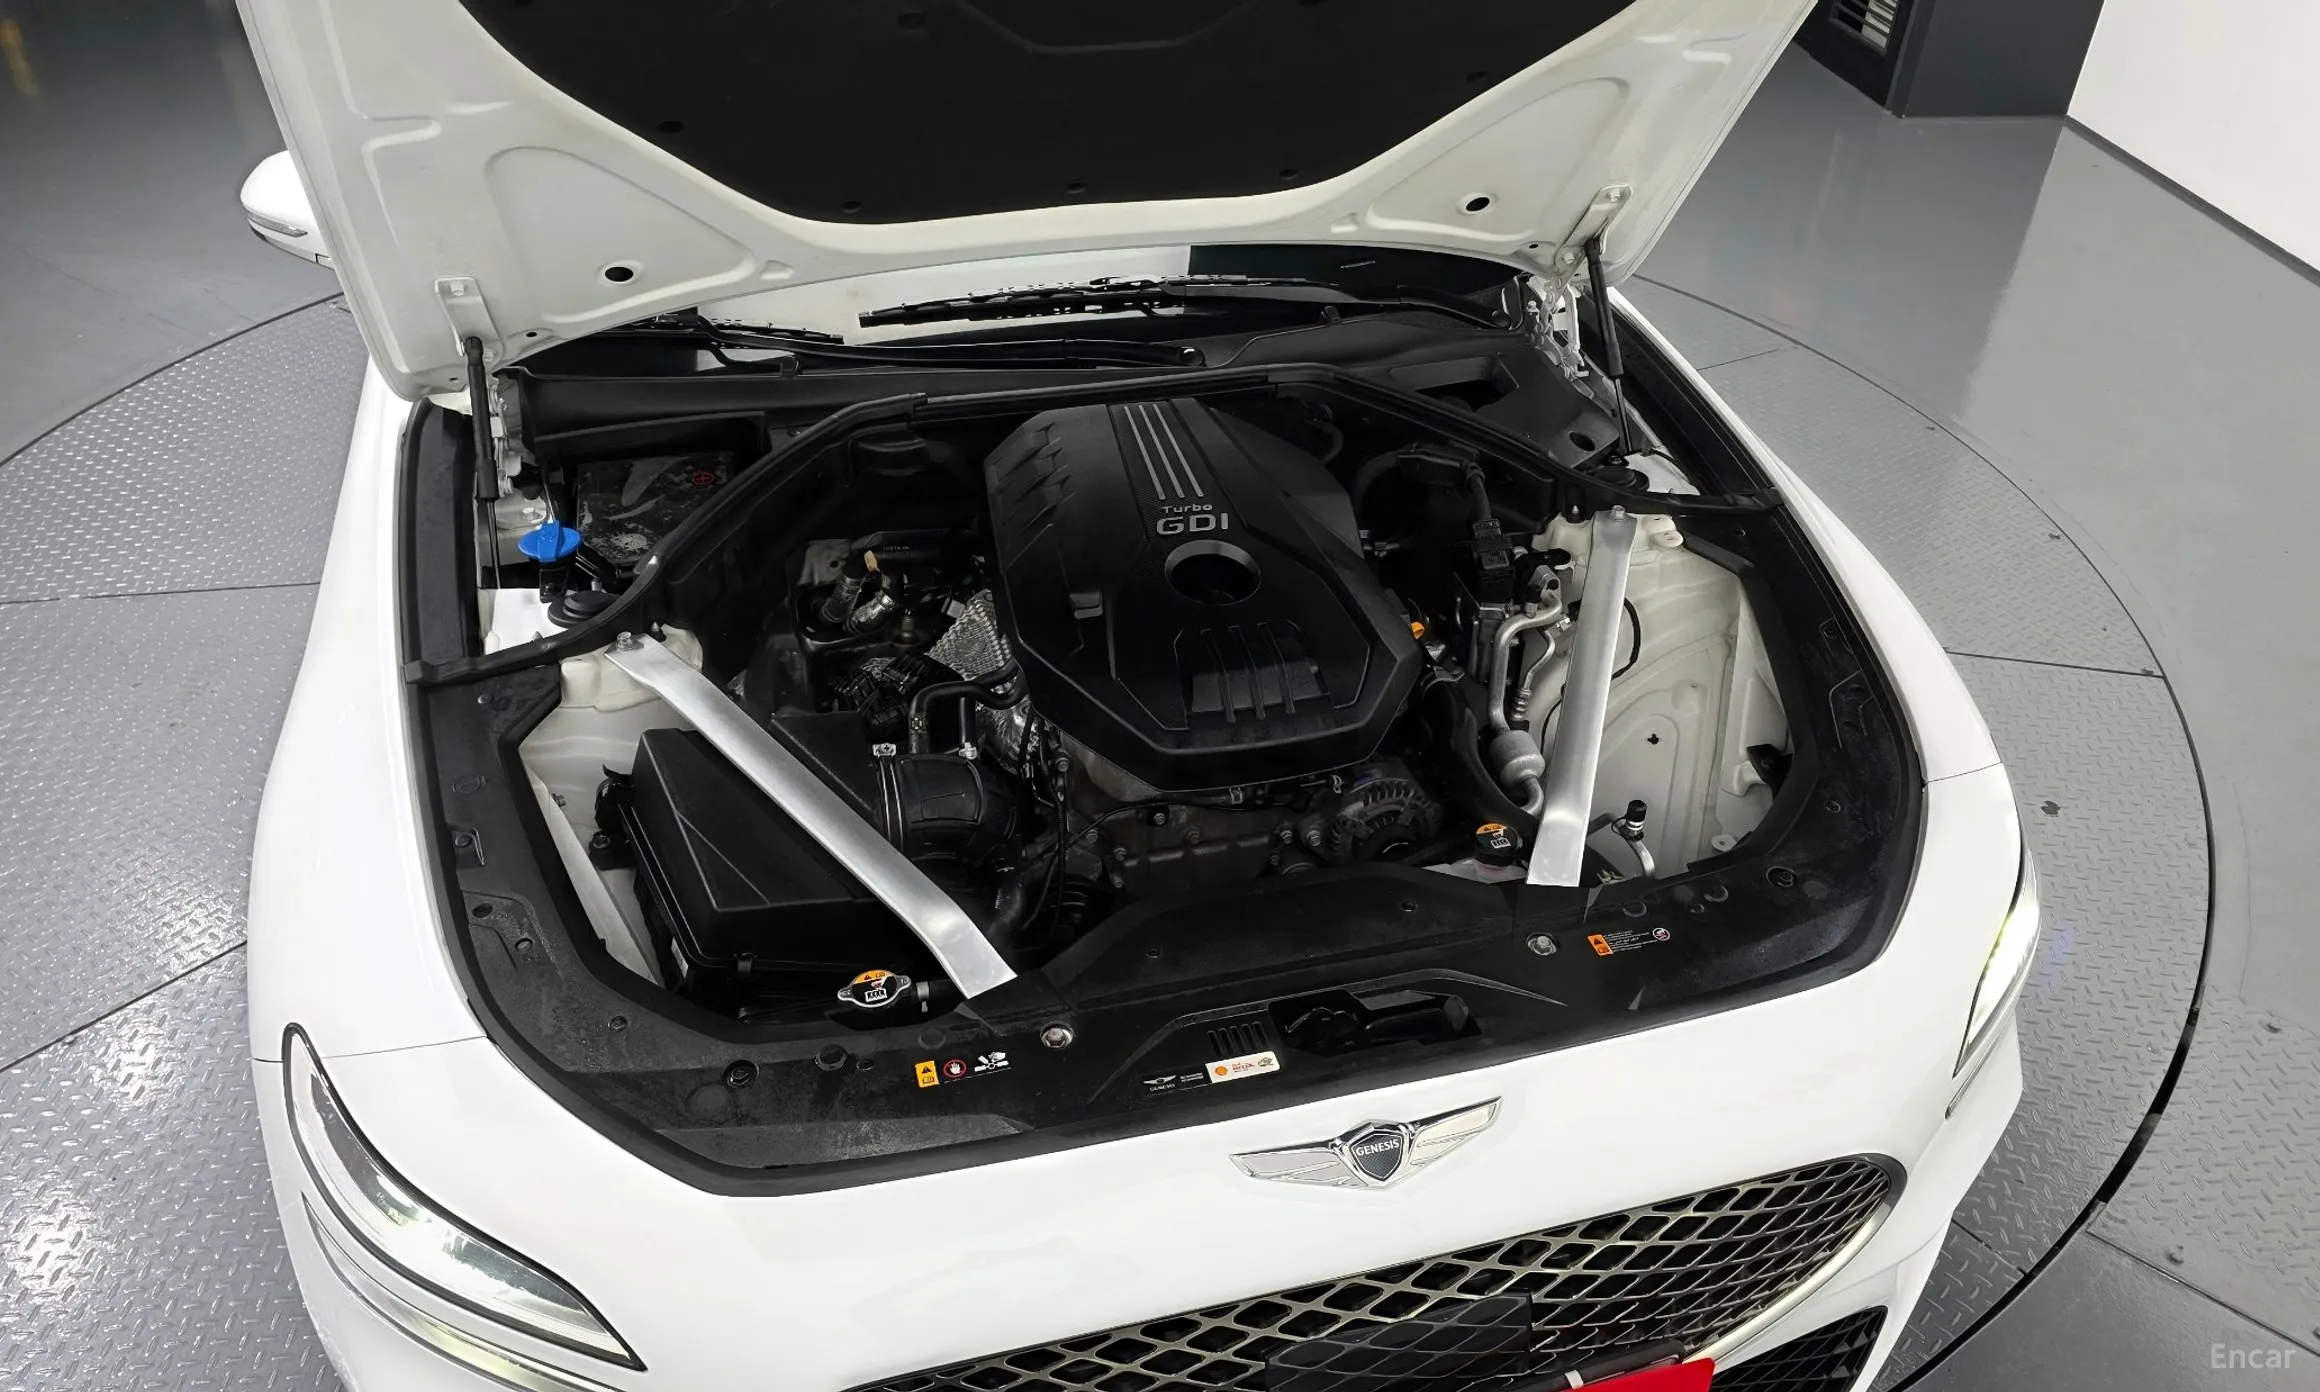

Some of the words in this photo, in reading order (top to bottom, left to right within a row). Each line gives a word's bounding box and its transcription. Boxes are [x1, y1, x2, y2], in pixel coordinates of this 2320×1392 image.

[1162, 504, 1213, 514] Turbo
[1156, 513, 1229, 535] GDI
[1355, 1139, 1400, 1156] GENESIS
